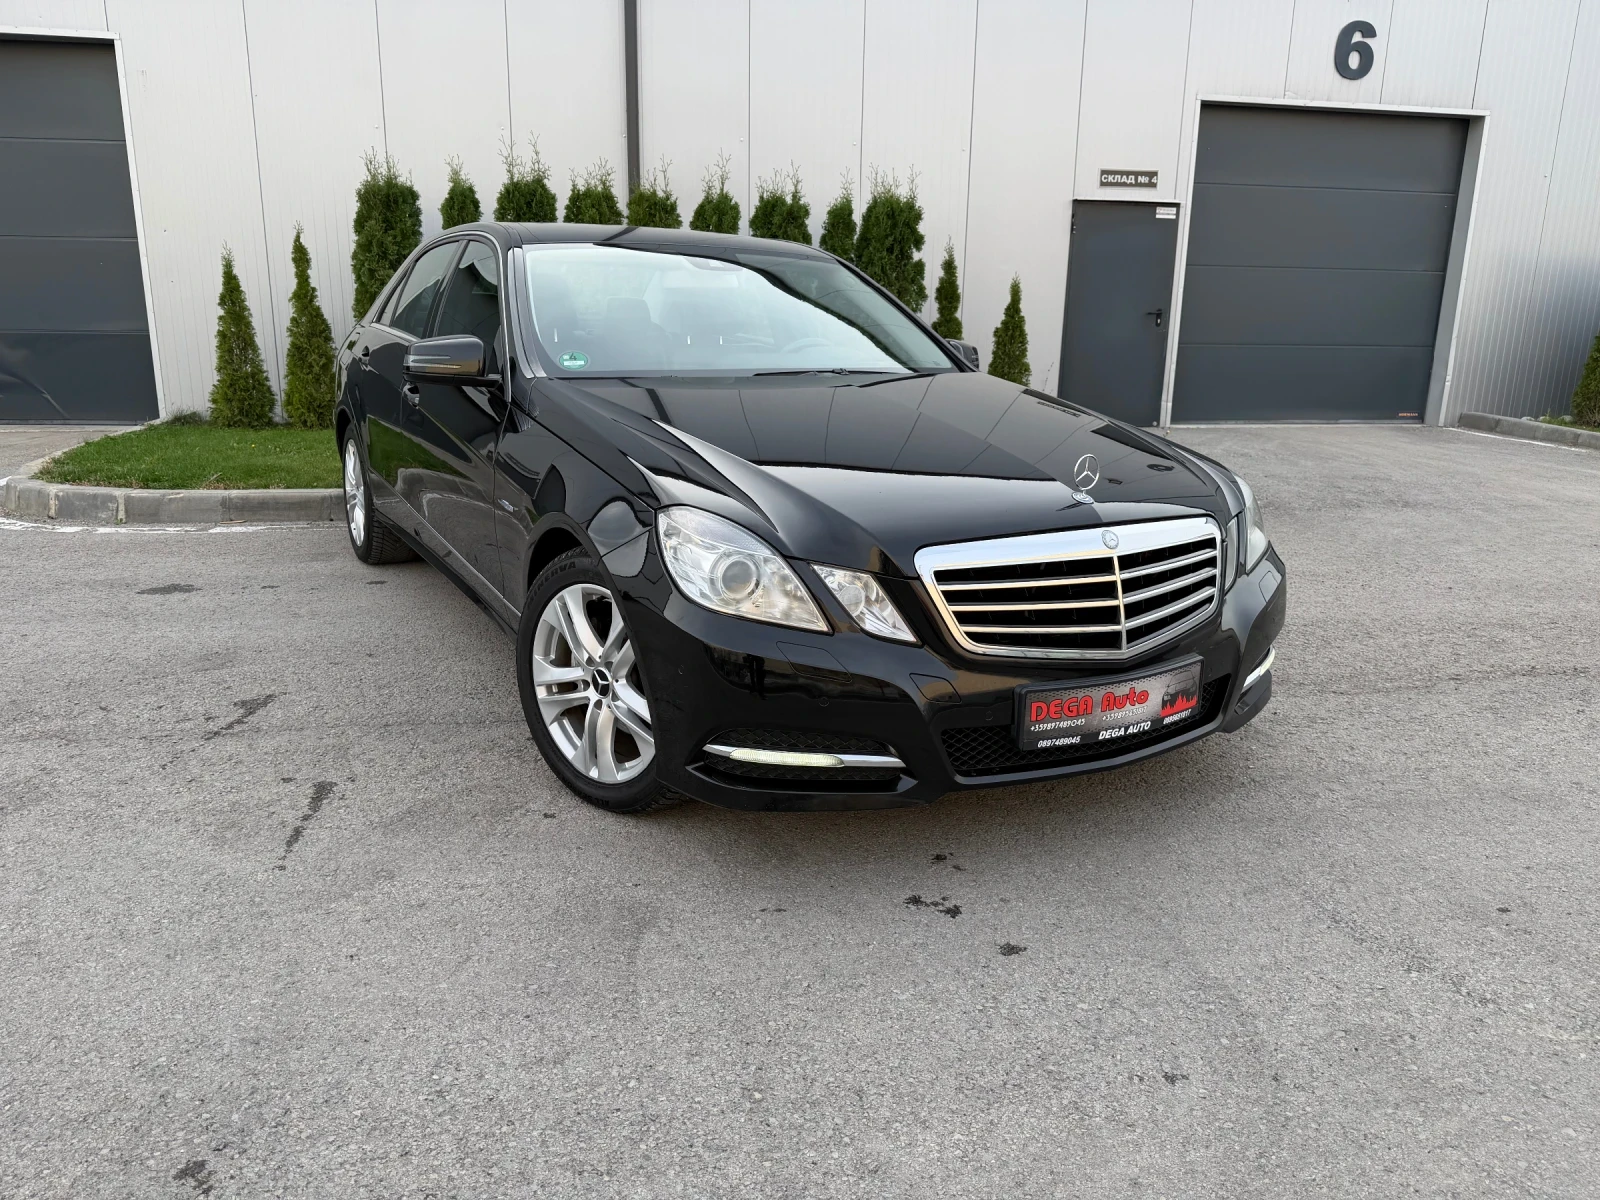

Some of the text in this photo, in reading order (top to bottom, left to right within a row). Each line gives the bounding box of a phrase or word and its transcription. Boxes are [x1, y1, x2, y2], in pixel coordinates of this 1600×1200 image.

[1334, 20, 1377, 80] 6
[1101, 174, 1157, 184] СКЛАД № 4
[569, 352, 577, 361] 4
[1030, 687, 1150, 721] DEGA Auto
[1030, 718, 1086, 732] +359897489045
[1098, 721, 1151, 740] DEGA AUTO
[1037, 736, 1081, 748] 0897489045
